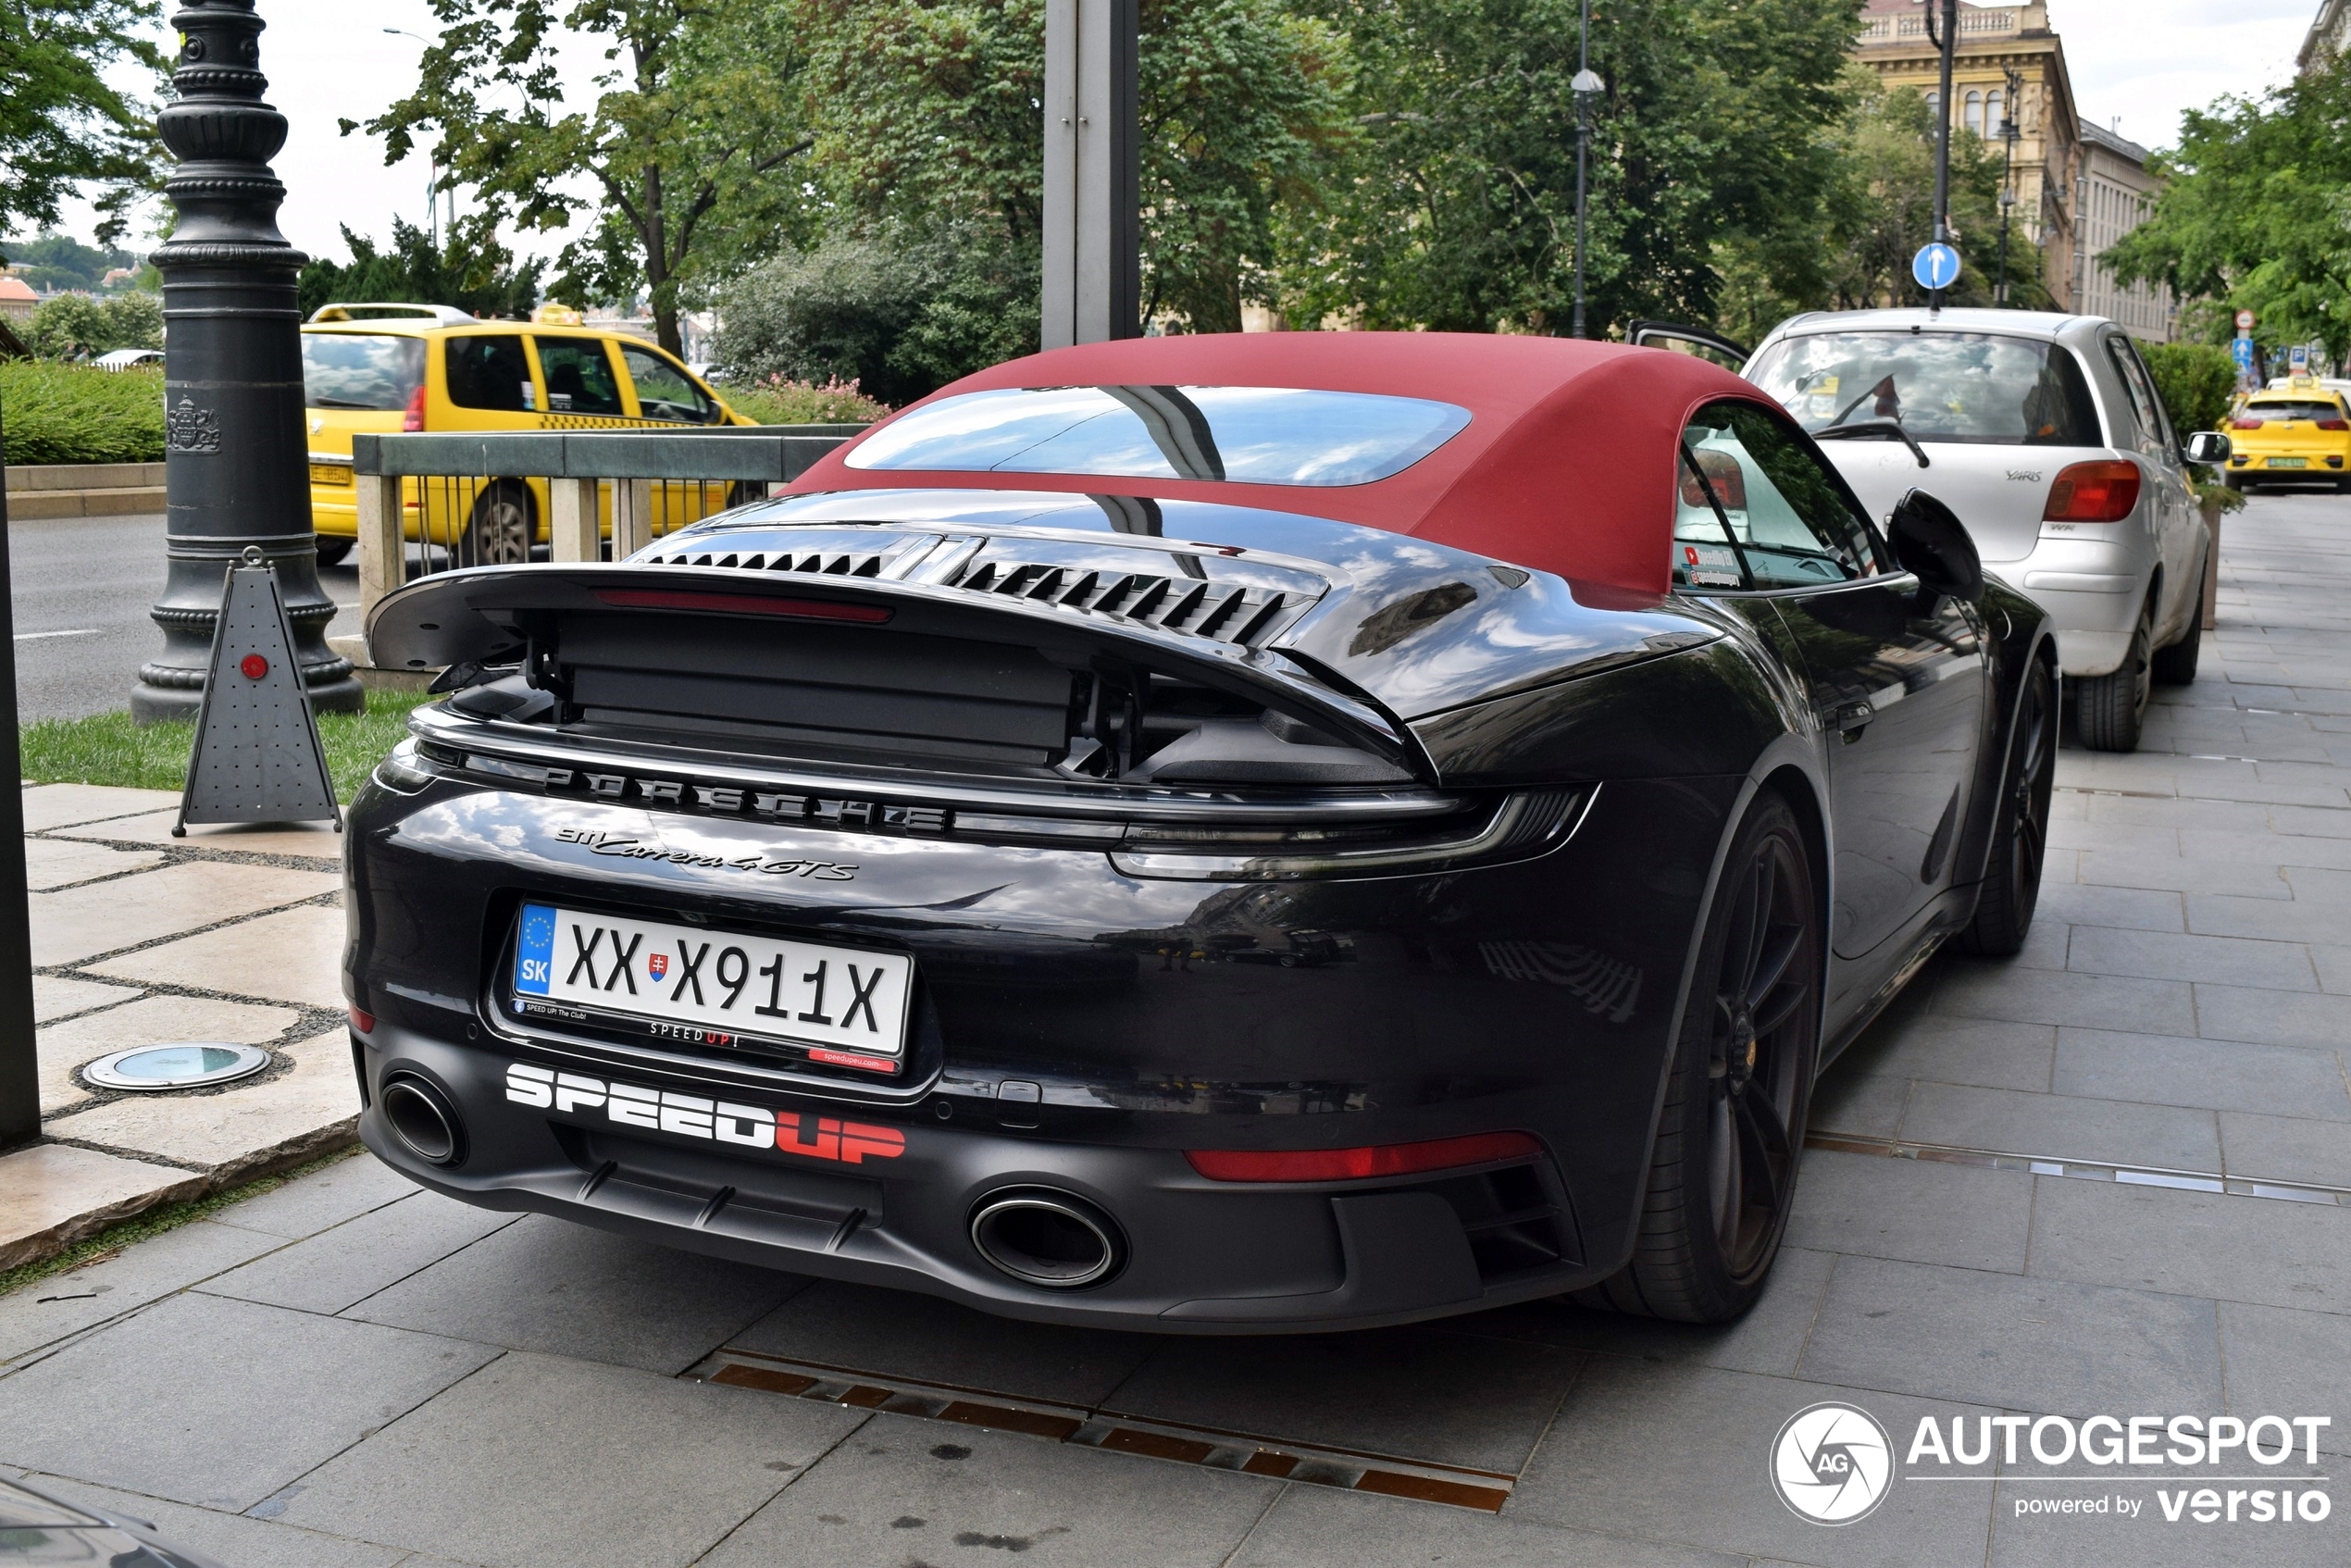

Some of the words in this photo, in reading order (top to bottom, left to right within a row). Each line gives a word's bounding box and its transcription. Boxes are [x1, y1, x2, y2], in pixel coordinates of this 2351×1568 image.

[2006, 469, 2042, 482] YARIS
[543, 767, 948, 831] PORSCHE
[554, 826, 606, 848] 911
[589, 836, 723, 868] Carrera
[759, 857, 860, 881] GTS
[522, 958, 547, 983] SK
[566, 924, 643, 996] XX
[669, 938, 885, 1034] X911X
[526, 1002, 546, 1014] SPEED
[558, 1008, 570, 1017] The
[570, 1010, 587, 1020] Club!
[824, 1052, 879, 1068] speedupeu.com
